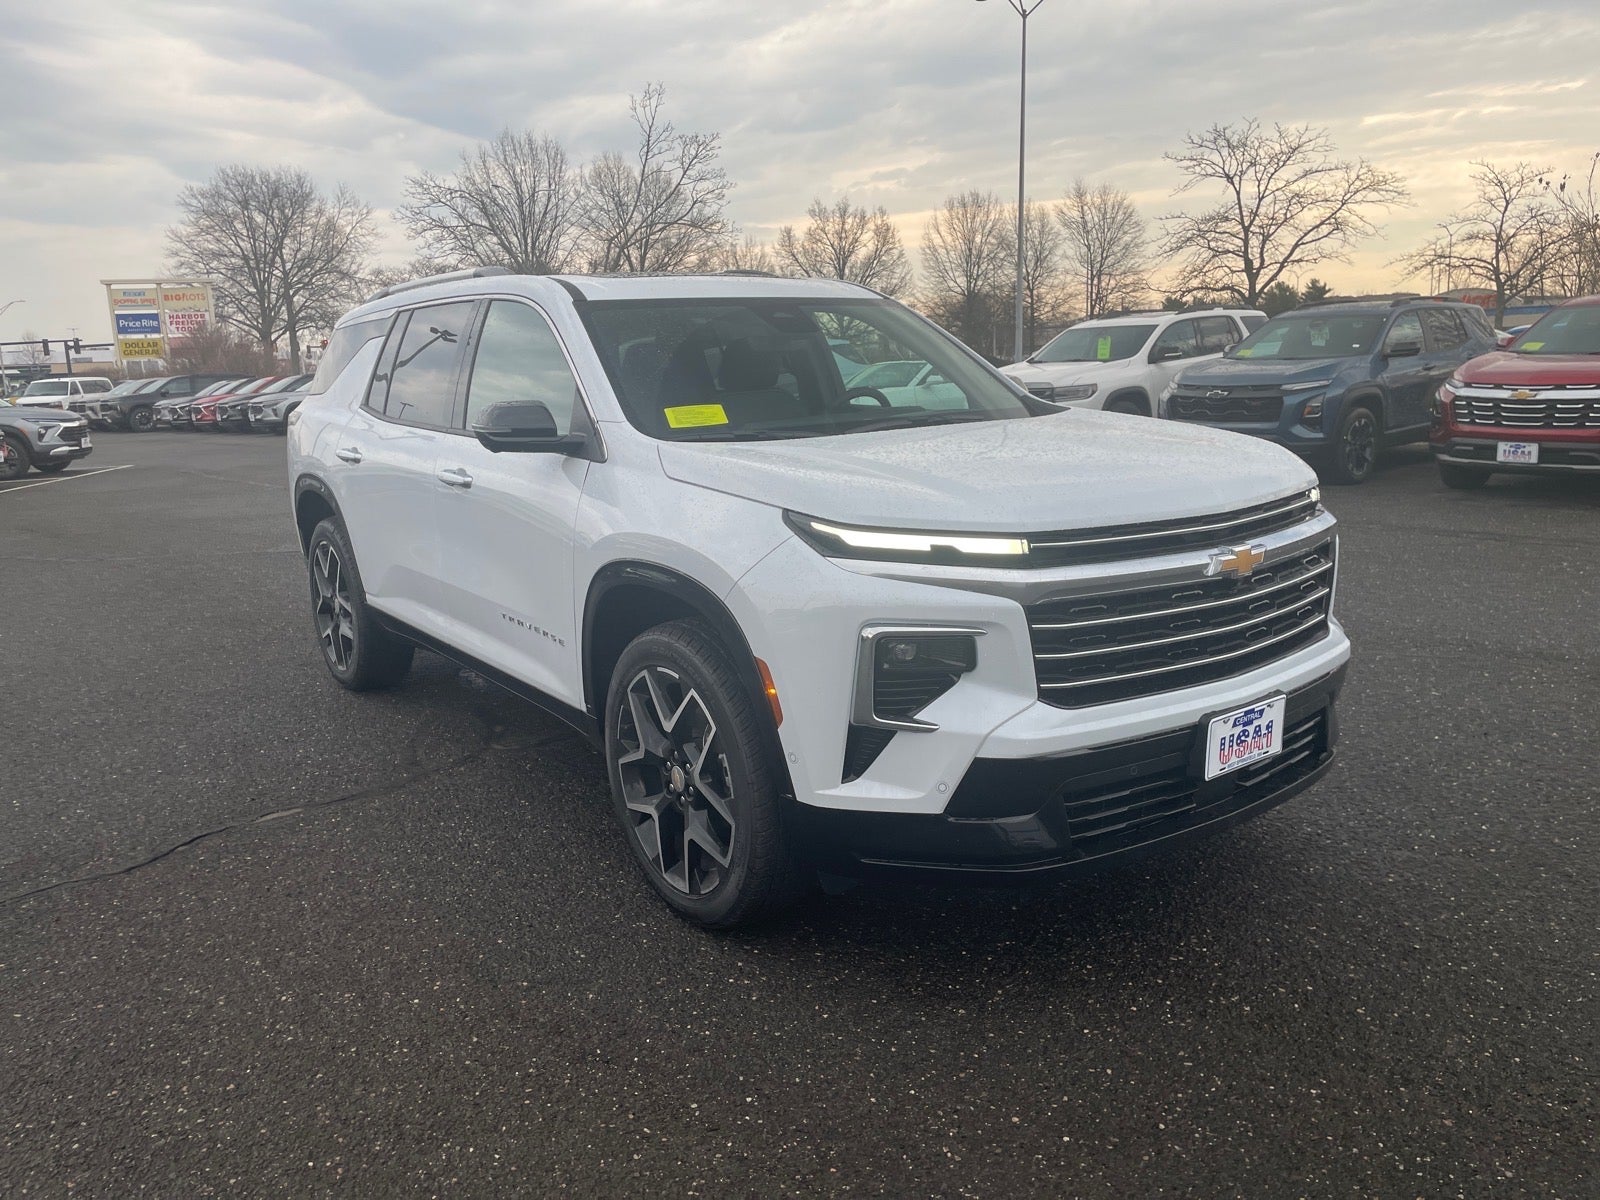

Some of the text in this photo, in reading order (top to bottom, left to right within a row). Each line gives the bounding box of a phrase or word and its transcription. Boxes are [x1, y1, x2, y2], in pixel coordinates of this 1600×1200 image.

[119, 319, 159, 328] Price Rite
[124, 341, 159, 349] DOLLAR
[501, 613, 566, 647] TRAVERSE
[1234, 711, 1262, 726] CENTRAL
